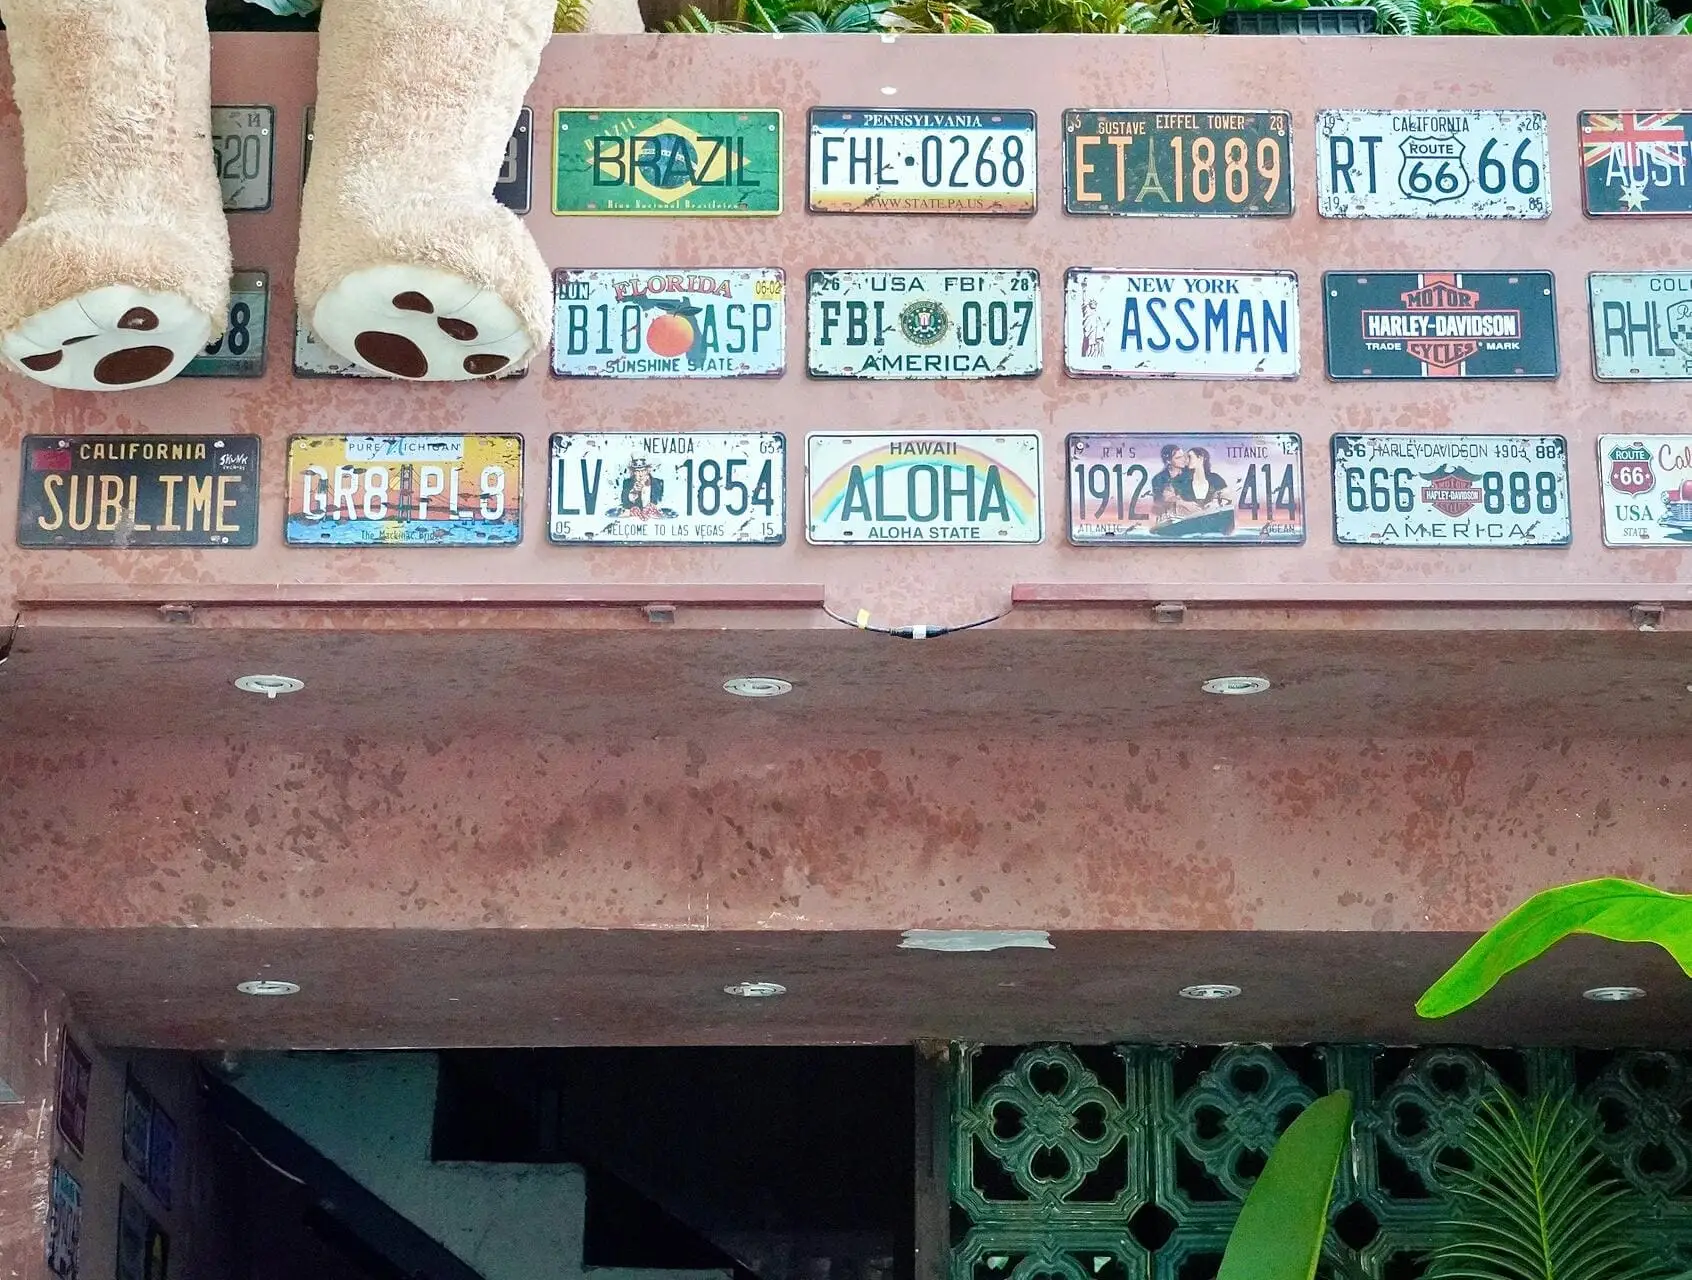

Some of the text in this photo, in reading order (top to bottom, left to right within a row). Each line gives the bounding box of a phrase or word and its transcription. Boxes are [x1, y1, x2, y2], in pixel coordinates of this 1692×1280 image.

[864, 114, 983, 128] PENNSYLVANIA
[1099, 114, 1245, 136] GUSTAVE EIFFEL TOWER
[1392, 117, 1470, 132] CALIFORNIA
[1525, 117, 1540, 131] 26
[1410, 144, 1454, 154] ROUTE
[593, 136, 760, 186] BRAZIL
[1075, 136, 1281, 203] ET 1889
[1330, 136, 1383, 194] RT
[1478, 137, 1540, 195] 66
[1605, 141, 1692, 186] AUST
[1408, 161, 1459, 194] 66
[1327, 197, 1340, 210] 19
[613, 274, 733, 301] FLORIDA
[755, 280, 782, 295] 06-02
[821, 278, 840, 291] 26
[871, 277, 985, 291] USA FBI
[1010, 278, 1029, 291] 28
[1127, 277, 1240, 294] NEW YORK
[1650, 278, 1692, 292] COL
[1407, 286, 1473, 308] MOTOR
[702, 304, 772, 353] ASP
[820, 301, 885, 346] FBI
[962, 301, 1034, 346] 007
[1120, 297, 1288, 353] ASSMAN
[1368, 315, 1516, 337] HARLEY-DAVIDSON
[1603, 301, 1675, 357] RHL
[1365, 342, 1402, 351] TRADE
[1410, 341, 1474, 364] CYCLES
[1486, 342, 1520, 351] MARK
[604, 358, 734, 373] SUNSHINE STATE
[861, 355, 990, 371] AMERICA
[79, 442, 206, 460] CALIFORNIA
[349, 443, 381, 452] PURE
[643, 437, 695, 454] NEVADA
[889, 441, 957, 455] HAWAII
[1226, 446, 1269, 459] TITANIC
[1372, 443, 1488, 459] HARLEY-DAVIDSON
[1535, 445, 1556, 459] 88
[1615, 450, 1646, 461] ROUTE
[1658, 443, 1692, 472] Cal
[1619, 466, 1645, 486] 66
[303, 464, 505, 521] GR8 PL8
[558, 459, 603, 516] LV
[680, 459, 774, 517] 1854
[841, 464, 1010, 522] ALOHA
[1074, 464, 1150, 521] 1912
[1238, 463, 1298, 521] 414
[1345, 467, 1415, 513] 666
[1483, 471, 1558, 515] 888
[38, 473, 242, 532] SUBLIME
[1615, 504, 1654, 522] USA
[606, 522, 725, 537] WELCOME TO LAS VEGAS
[761, 522, 774, 536] 15
[867, 526, 981, 539] ALOHA STATE
[1077, 523, 1122, 534] ATLANTIC
[1381, 523, 1526, 538] AMERICA
[1623, 527, 1648, 538] STATE
